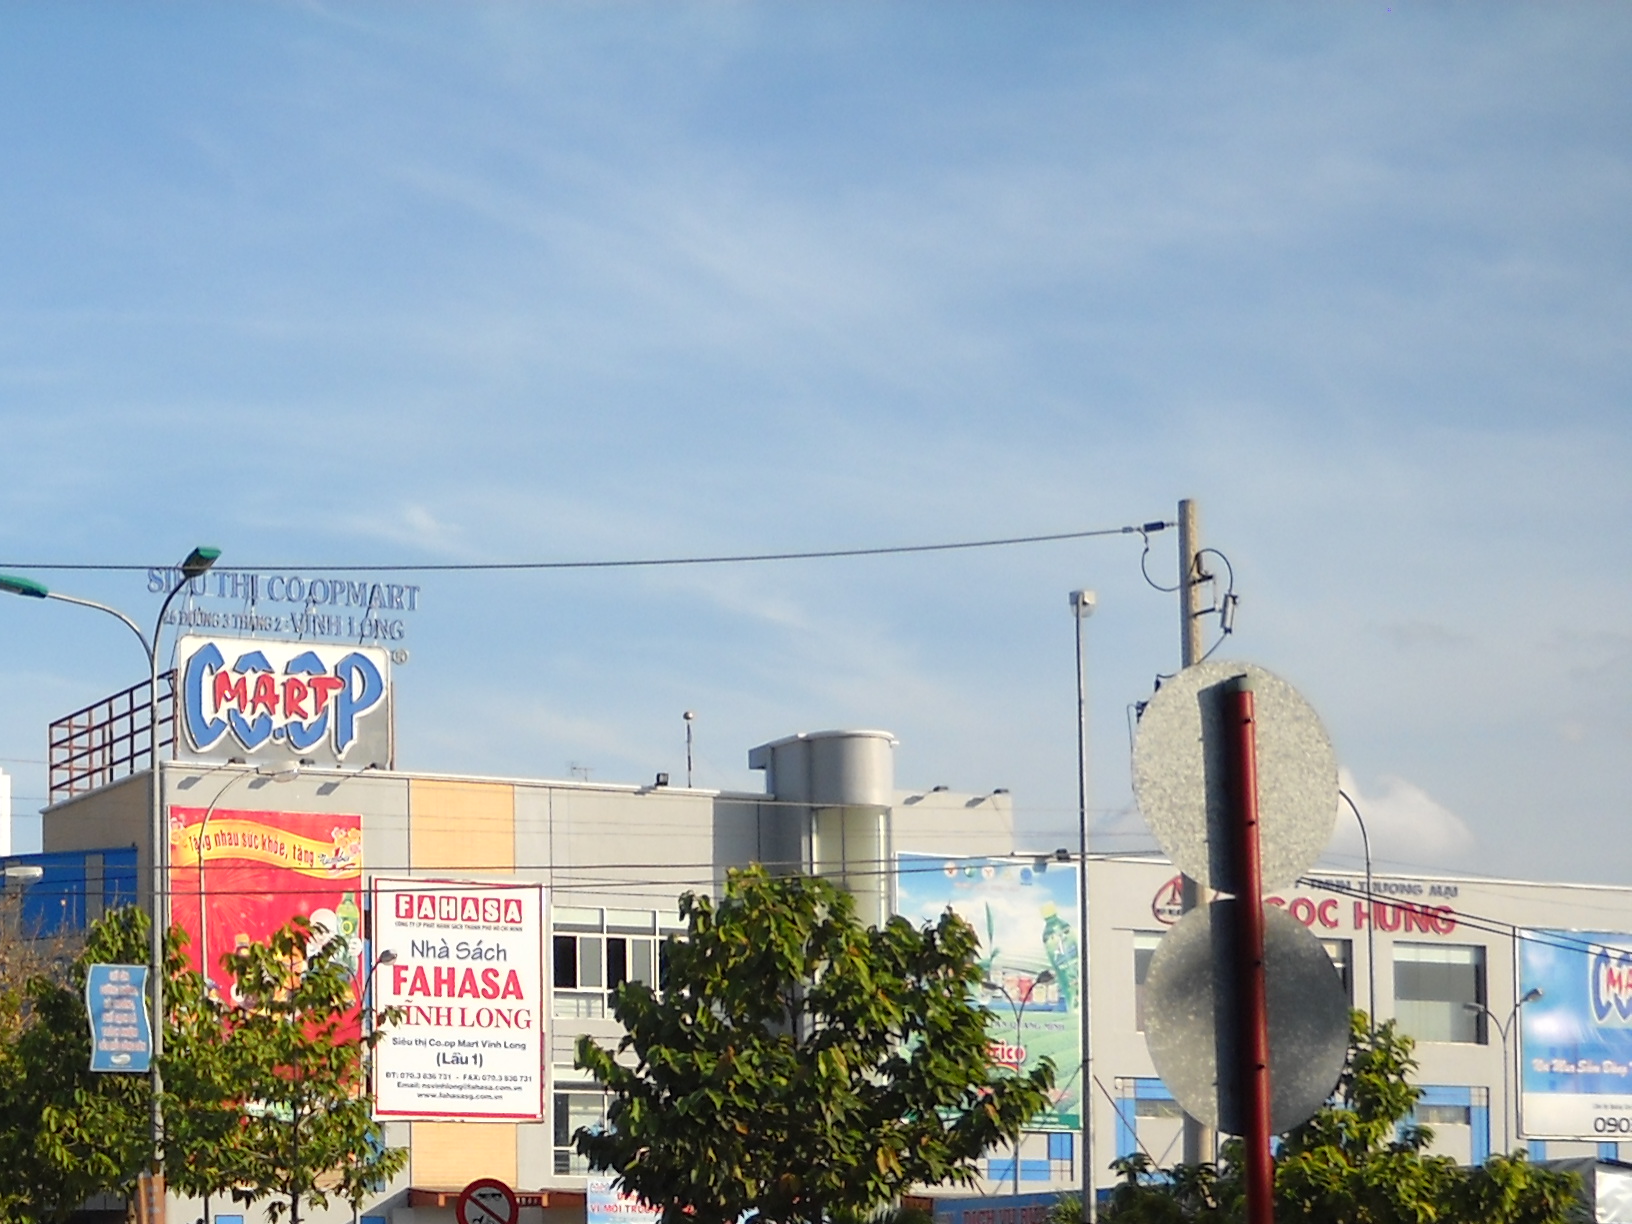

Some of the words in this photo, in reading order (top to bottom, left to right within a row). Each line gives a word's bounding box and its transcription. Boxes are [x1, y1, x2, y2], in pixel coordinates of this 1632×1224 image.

[214, 670, 345, 720] MART
[214, 829, 239, 847] nhau
[395, 894, 523, 924] FAHASA
[411, 938, 450, 959] Nhà
[456, 939, 507, 962] Sách
[392, 964, 524, 1001] FAHASA
[385, 999, 453, 1026] ĨNH
[458, 1006, 532, 1029] LONG
[1593, 1116, 1632, 1134] 090
